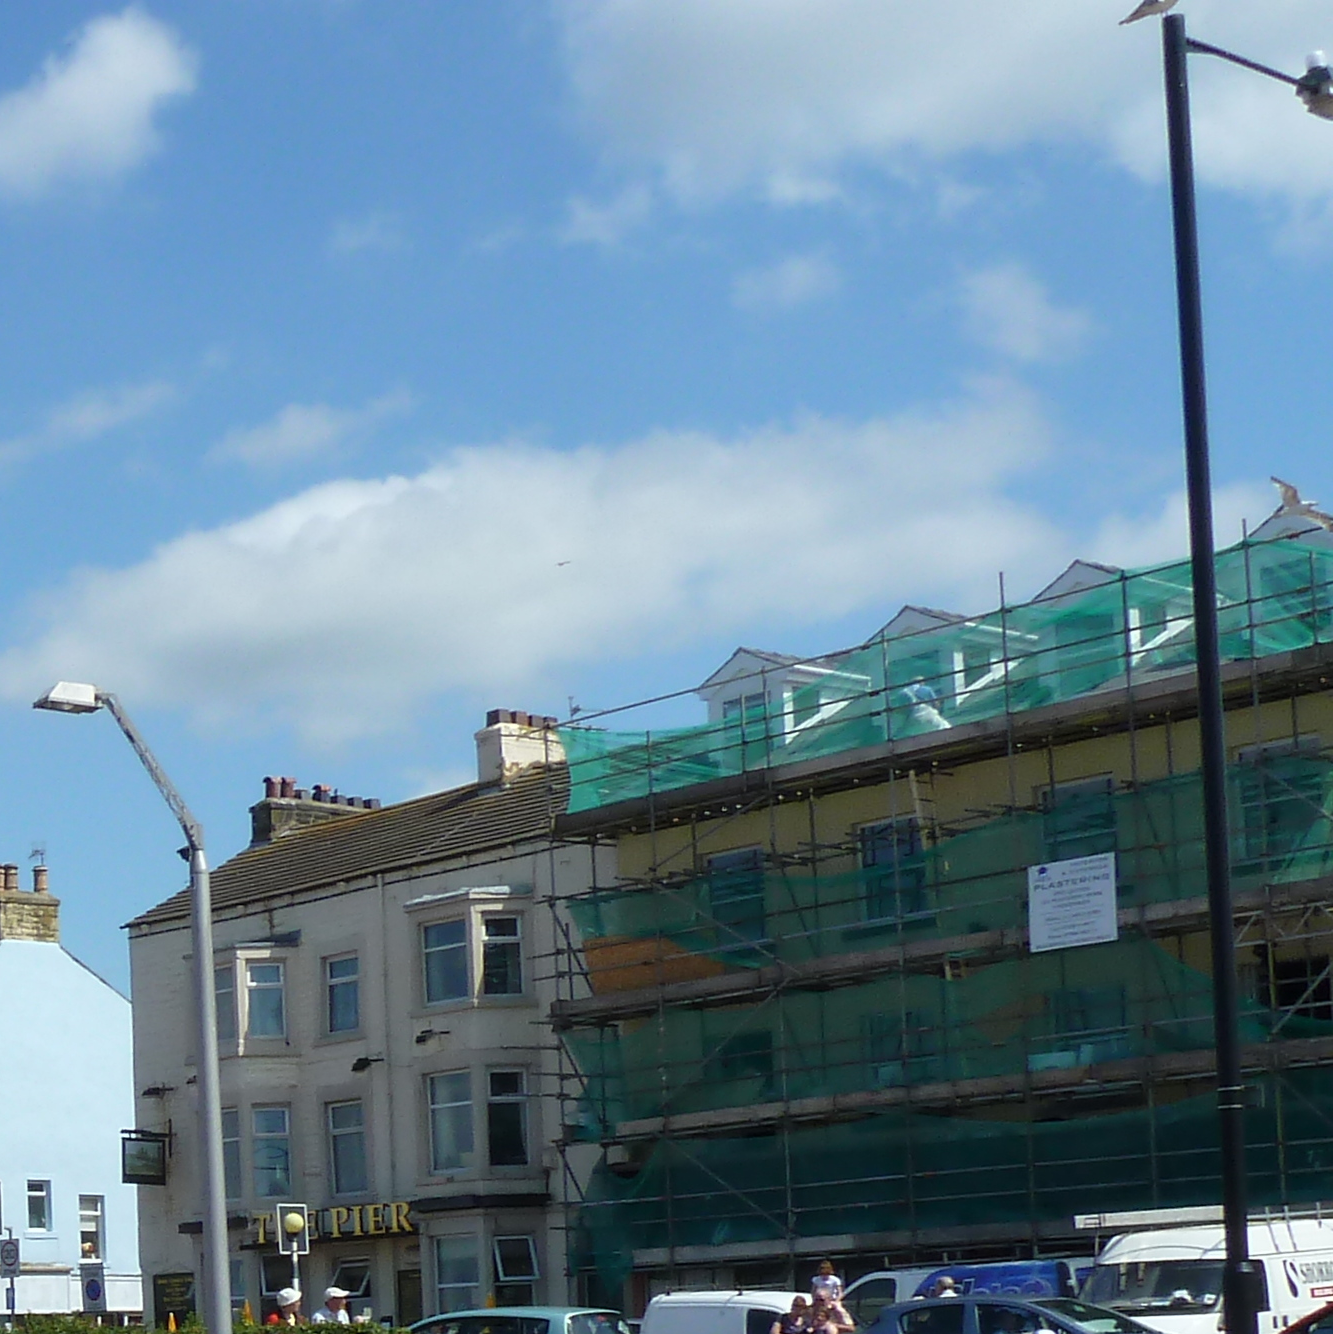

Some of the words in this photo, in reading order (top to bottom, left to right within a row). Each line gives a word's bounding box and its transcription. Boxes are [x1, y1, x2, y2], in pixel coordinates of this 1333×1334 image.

[1033, 873, 1110, 892] PLASTERING
[252, 1209, 320, 1245] TE
[329, 1201, 414, 1239] PIER
